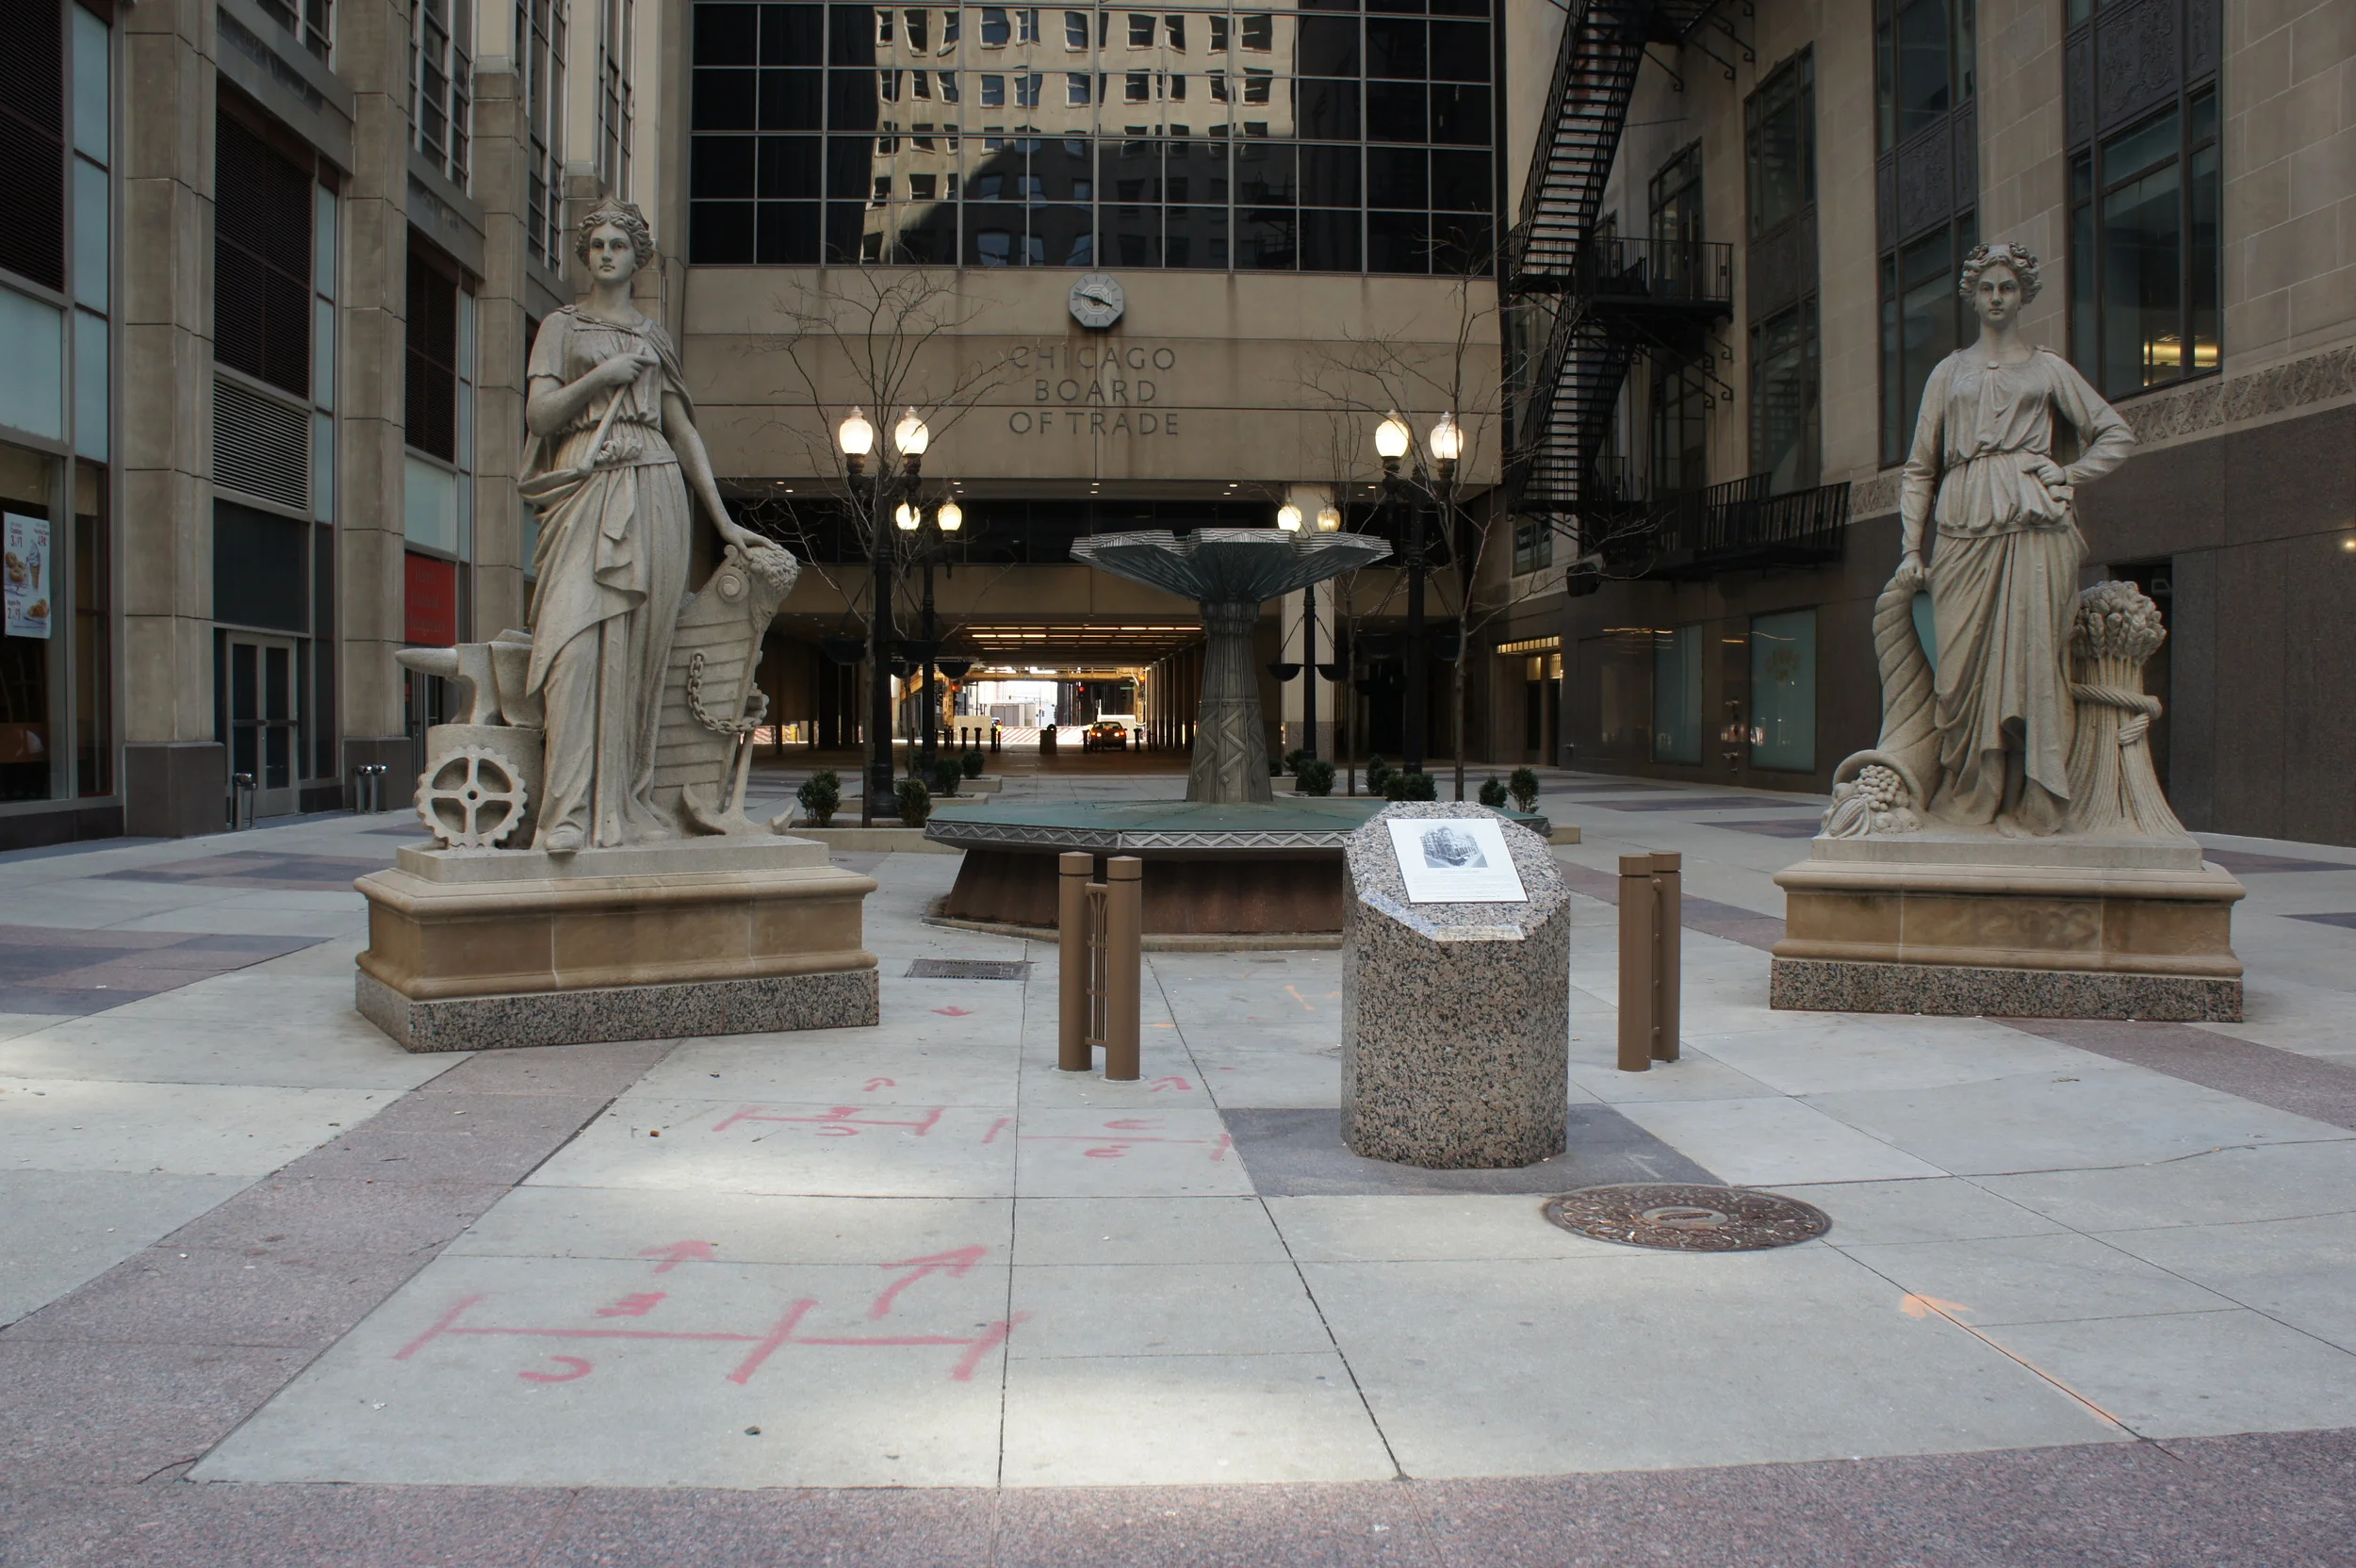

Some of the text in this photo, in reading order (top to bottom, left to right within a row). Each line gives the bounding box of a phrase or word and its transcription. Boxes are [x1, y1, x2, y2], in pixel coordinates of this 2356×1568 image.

[1011, 346, 1176, 371] CHICAGO
[1035, 379, 1157, 403] BOARD
[1008, 411, 1179, 436] OF TRADE
